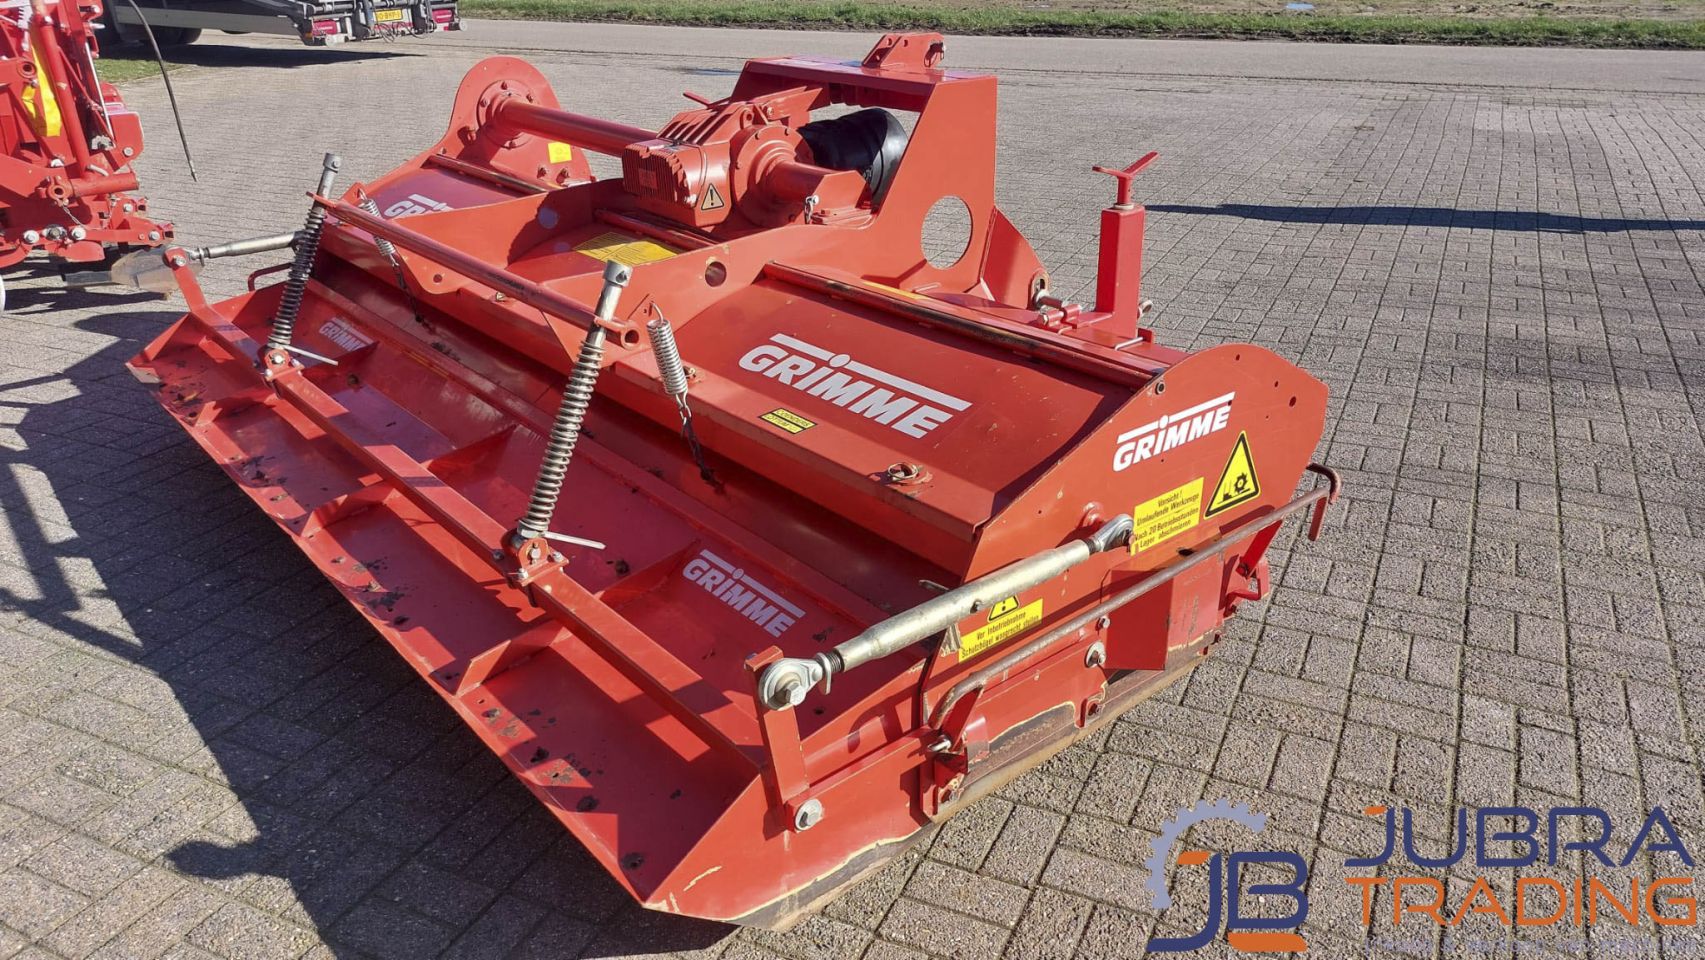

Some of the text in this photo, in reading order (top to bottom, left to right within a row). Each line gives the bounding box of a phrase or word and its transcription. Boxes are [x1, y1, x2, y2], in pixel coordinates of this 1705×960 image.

[738, 341, 954, 439] GRIMME
[1112, 401, 1232, 472] GRIMME
[1136, 493, 1200, 526] Umlaufende Werkzeuge
[1140, 519, 1192, 549] Lager abschmieren
[1149, 524, 1157, 536] 20
[682, 558, 797, 639] GRIMME
[976, 611, 1027, 641] Vor Inbetriebnahme
